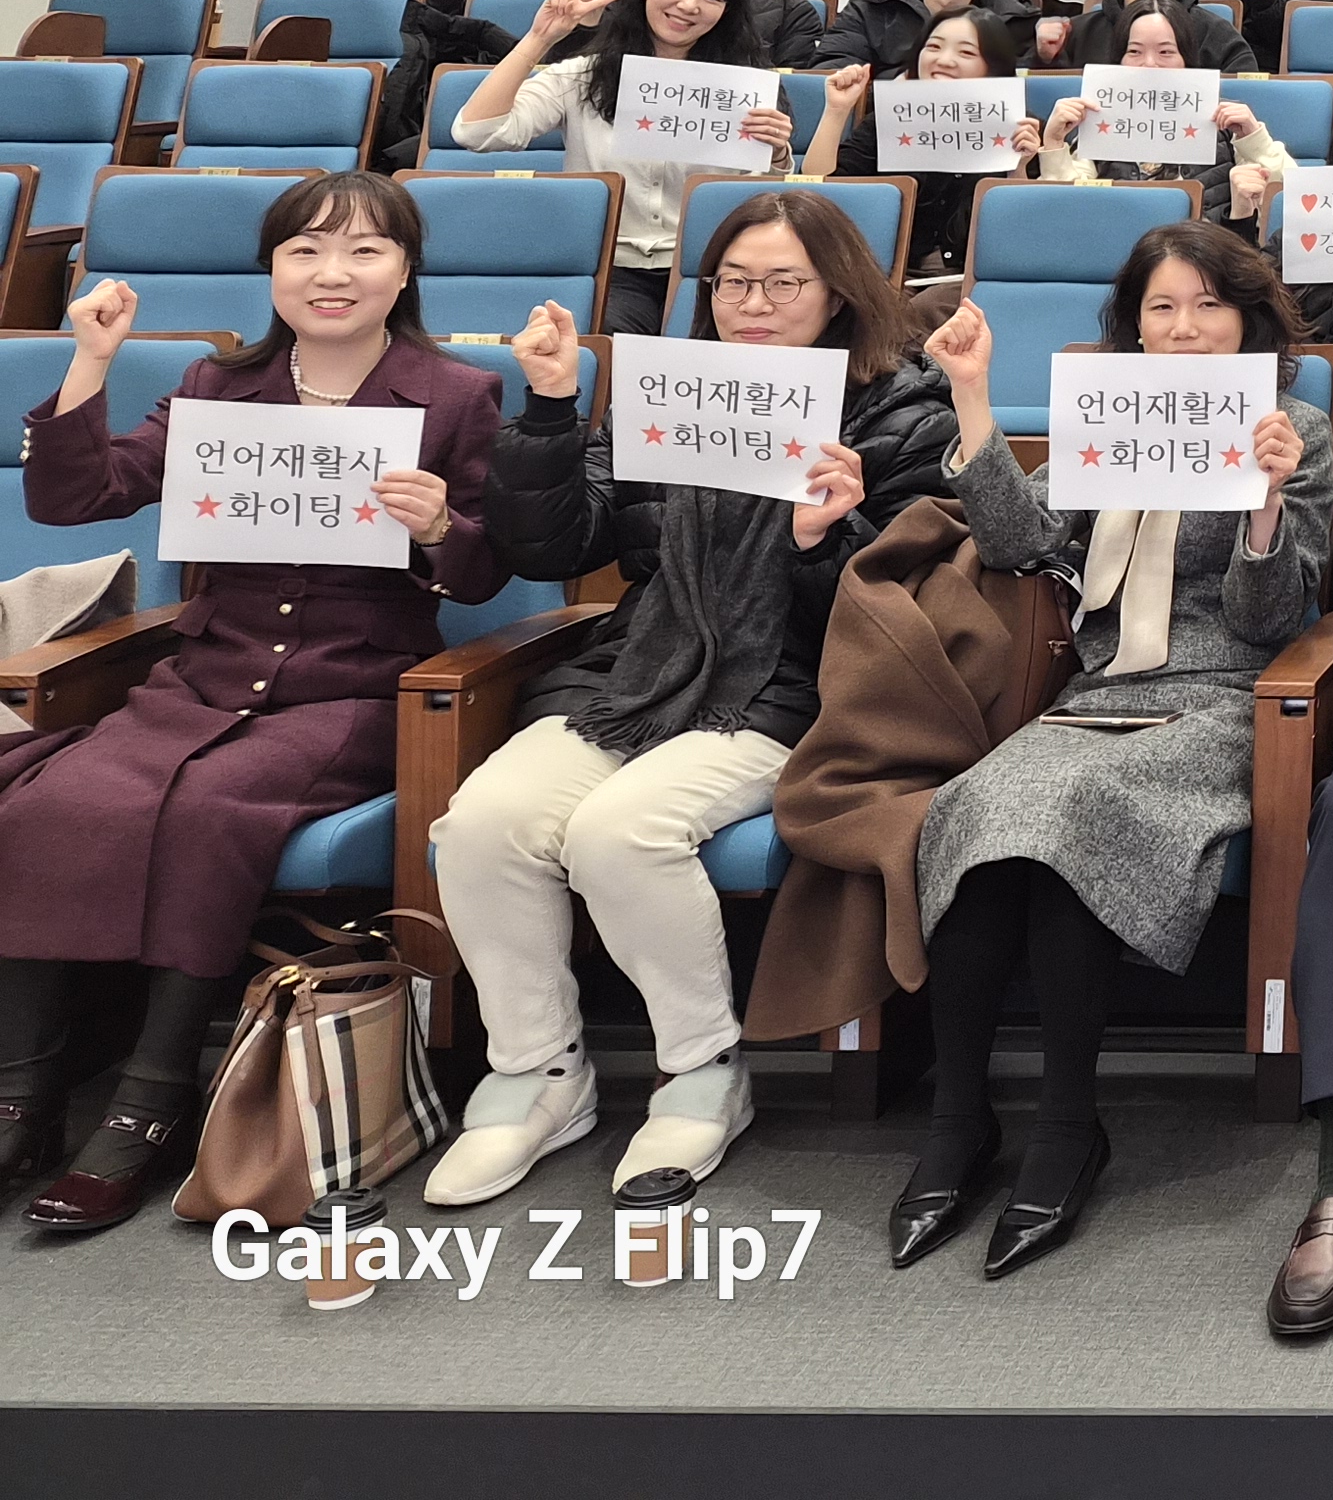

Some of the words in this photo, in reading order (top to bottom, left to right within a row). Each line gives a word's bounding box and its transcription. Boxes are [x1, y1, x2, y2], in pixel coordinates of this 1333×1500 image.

[638, 81, 762, 112] 언어재활사
[892, 100, 1009, 124] 언어재활사
[1096, 87, 1202, 113] 언어재활사
[657, 115, 732, 143] 화이팅
[916, 130, 985, 151] 화이팅
[1113, 118, 1178, 141] 화이팅
[639, 373, 817, 419] 언어재활사
[1076, 389, 1251, 427] 언어재활사
[672, 423, 774, 460] 화이팅
[1109, 437, 1211, 474] 화이팅
[195, 439, 389, 483] 언어재활사
[226, 489, 342, 529] 화이팅
